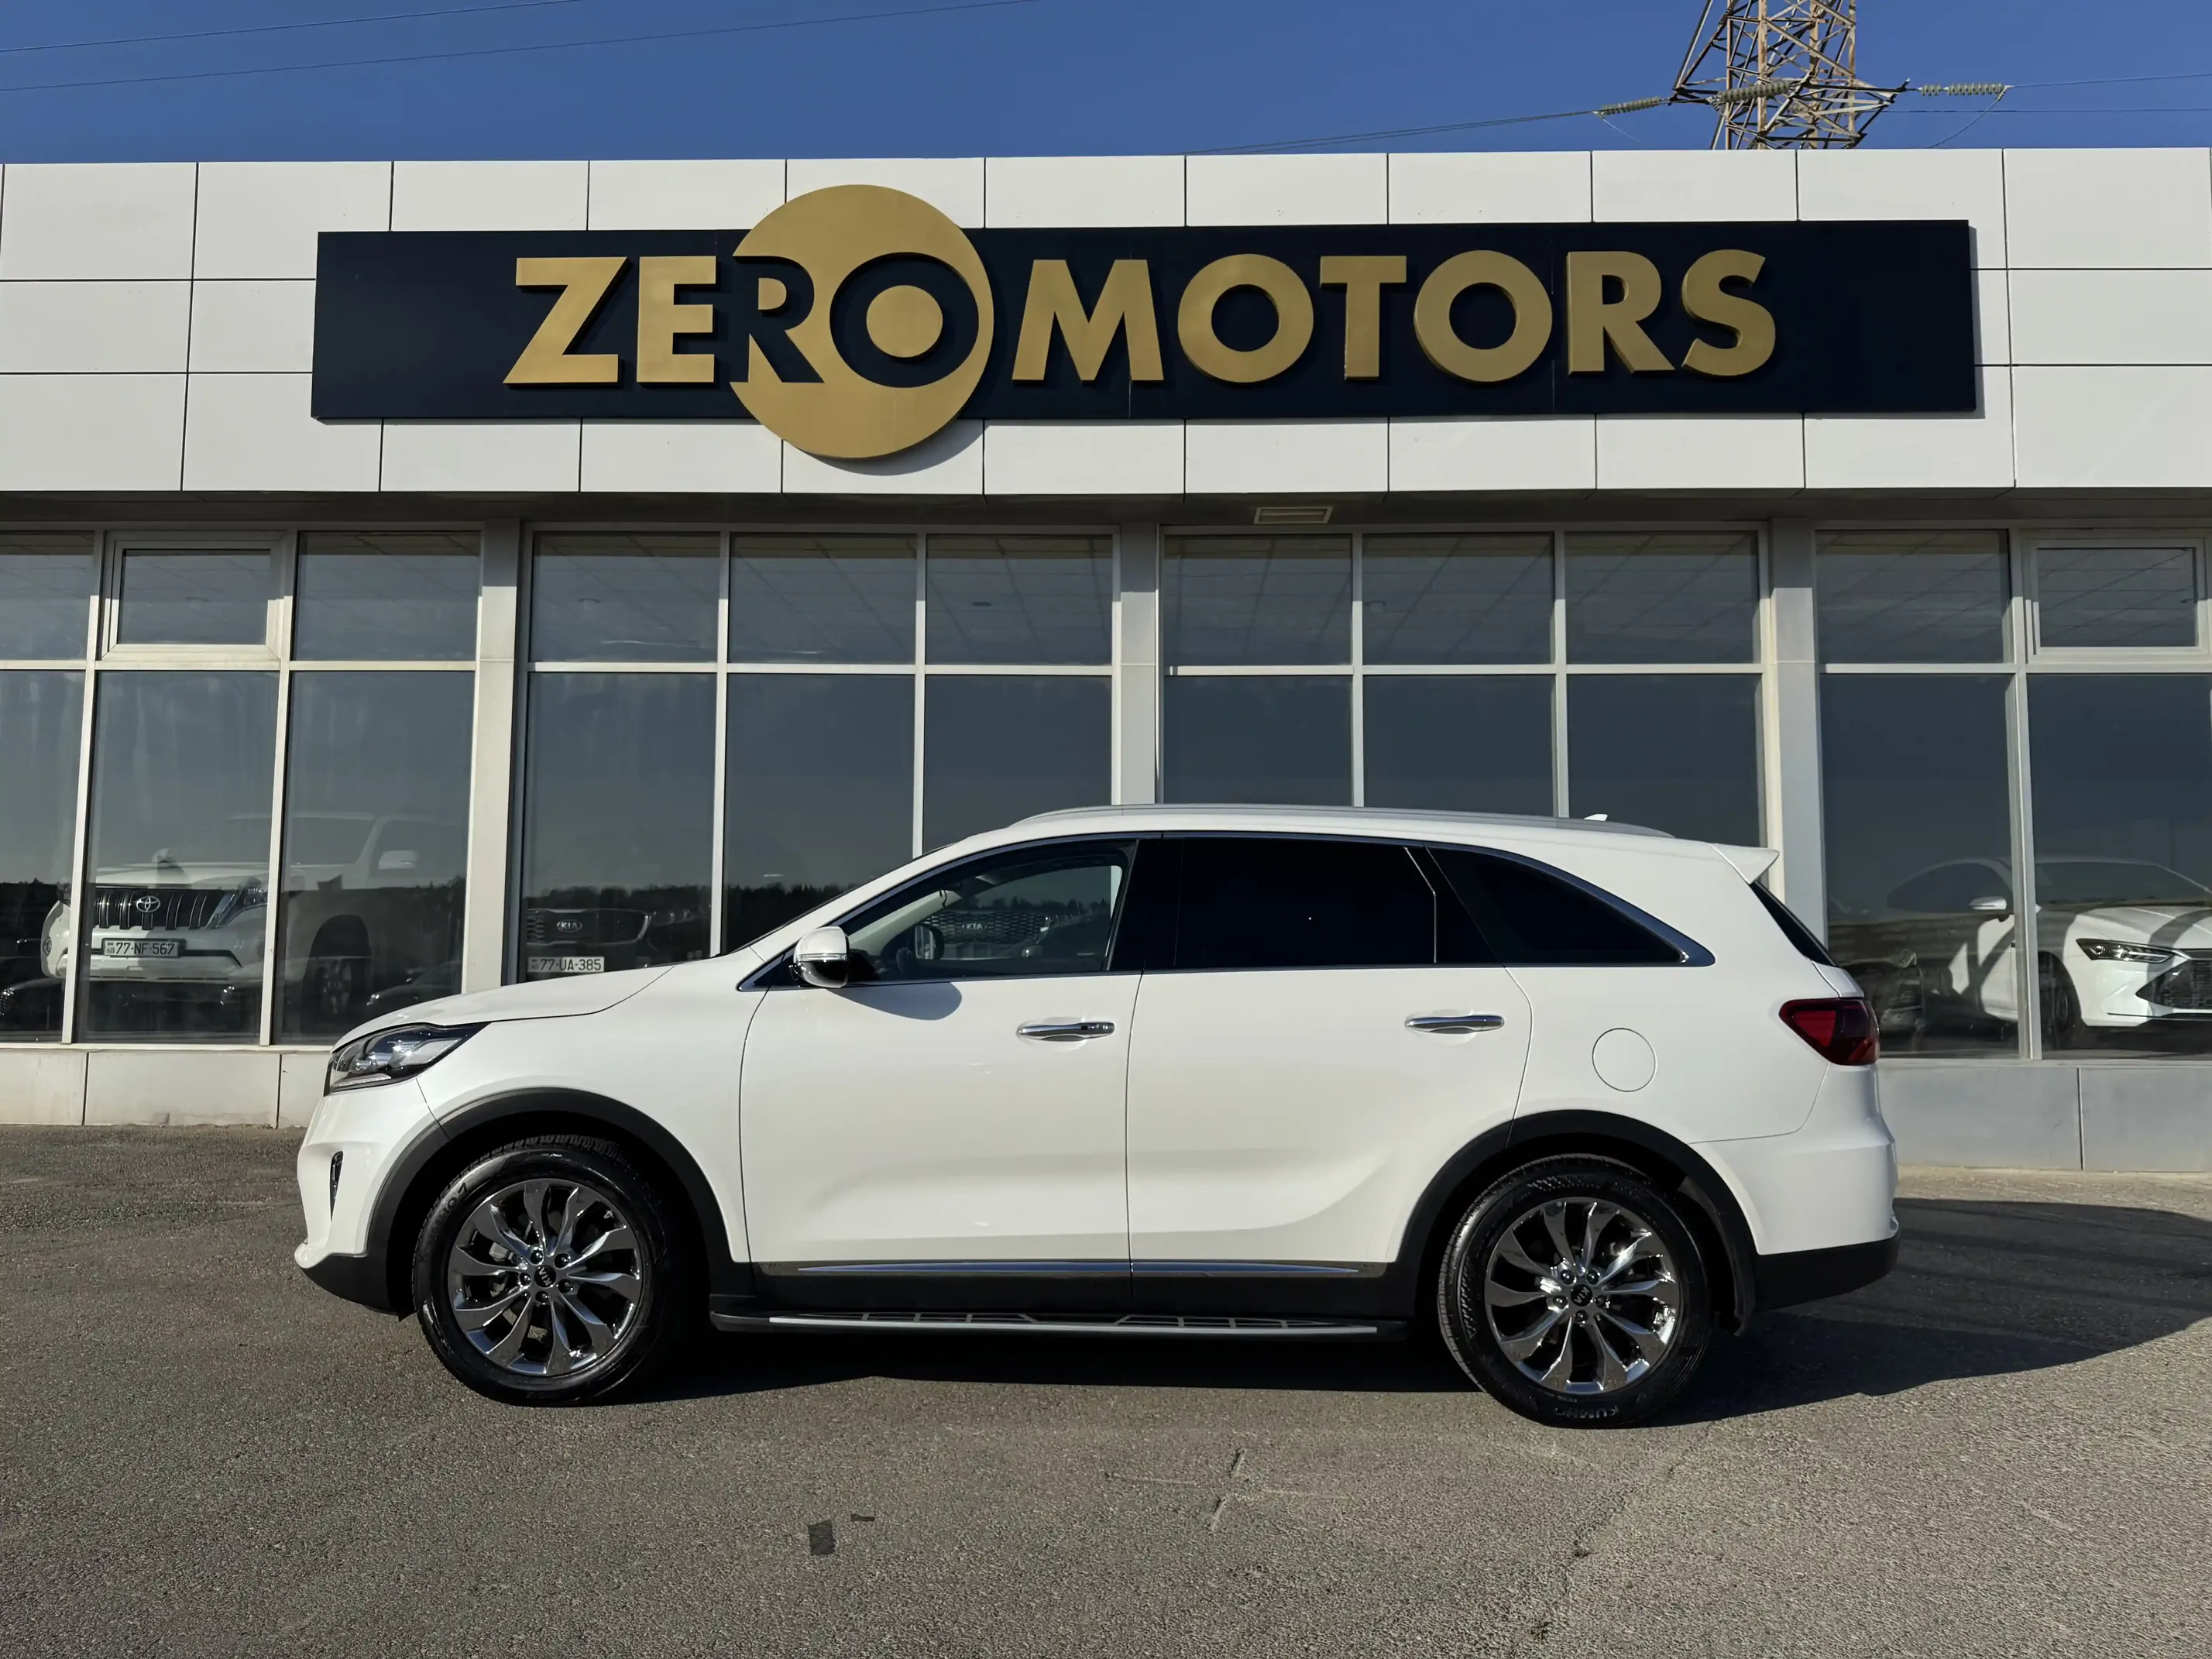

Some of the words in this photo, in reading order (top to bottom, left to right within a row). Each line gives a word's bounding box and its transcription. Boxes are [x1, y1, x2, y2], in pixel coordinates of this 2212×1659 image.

[503, 252, 981, 389] ZERO
[1012, 249, 1777, 384] MOTORS
[561, 922, 579, 930] KIA
[966, 922, 984, 931] KIA
[538, 1266, 552, 1286] KIA
[1574, 1286, 1590, 1304] KIA
